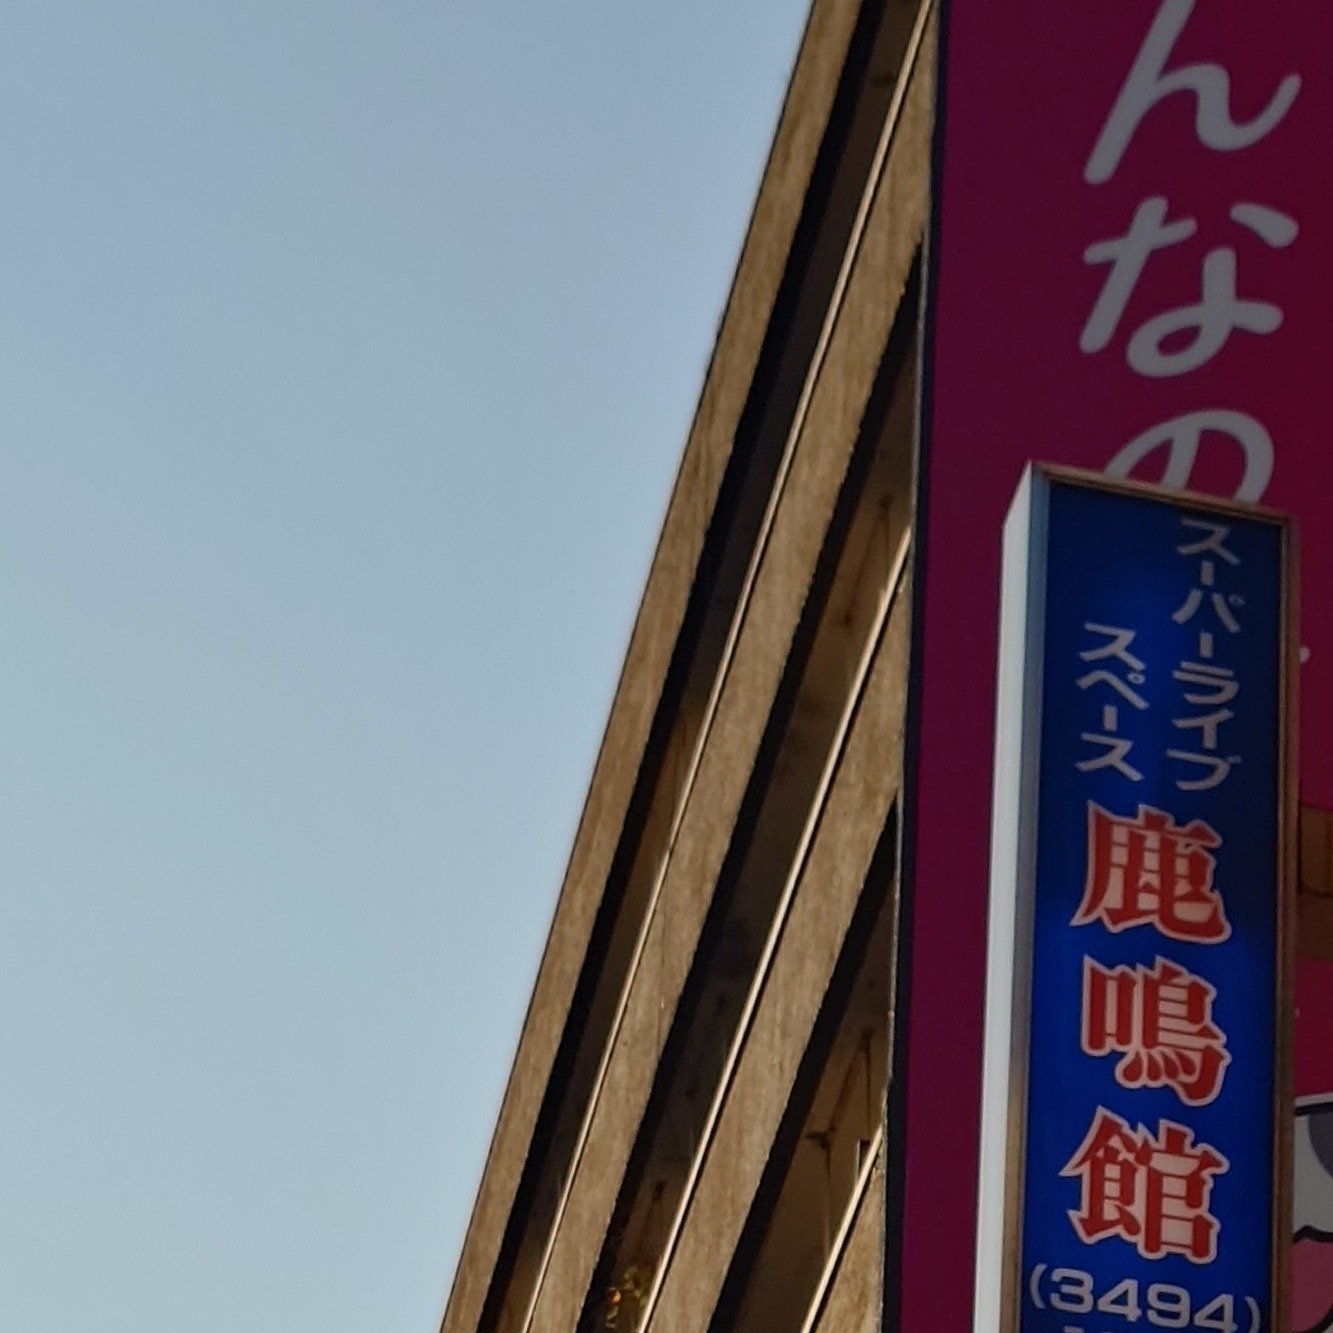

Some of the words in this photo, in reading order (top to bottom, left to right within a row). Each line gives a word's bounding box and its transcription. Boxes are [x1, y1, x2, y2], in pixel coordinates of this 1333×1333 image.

[1074, 621, 1150, 783] スペース
[1166, 518, 1246, 791] スーパーライブ
[1059, 799, 1233, 1265] 鹿鳴館
